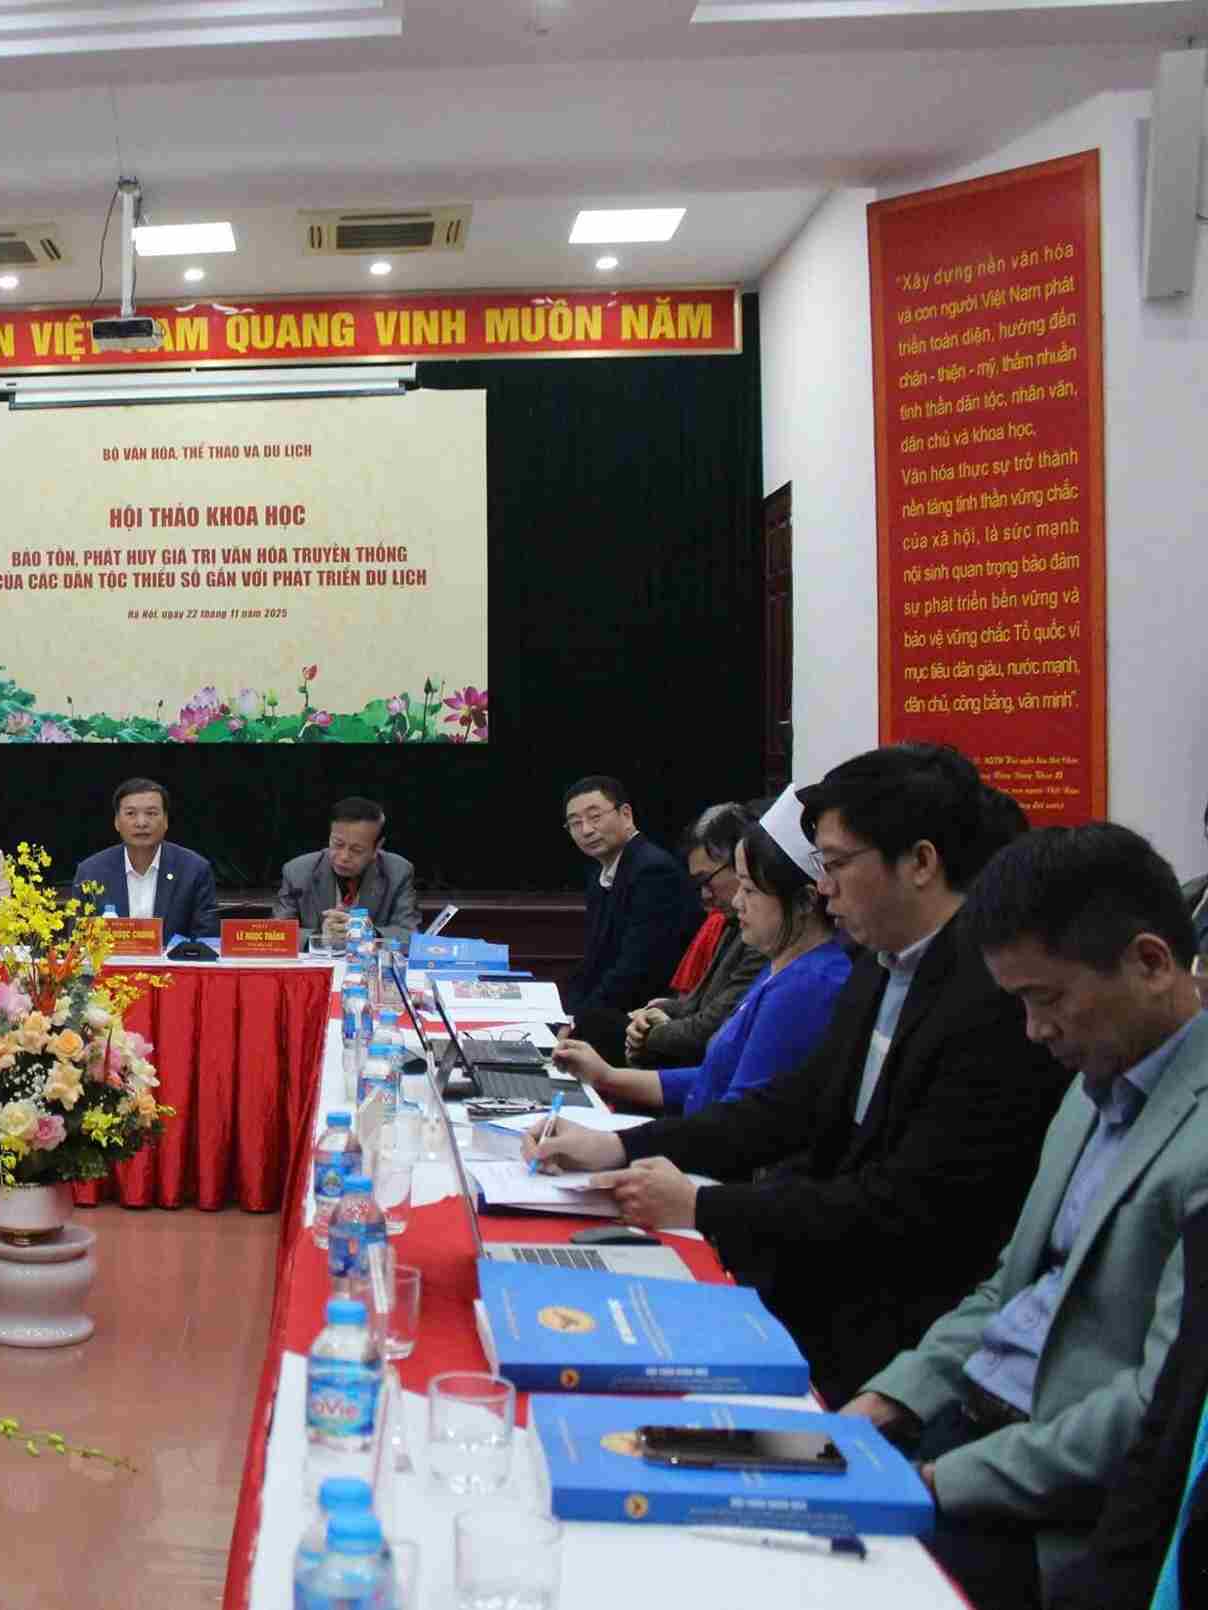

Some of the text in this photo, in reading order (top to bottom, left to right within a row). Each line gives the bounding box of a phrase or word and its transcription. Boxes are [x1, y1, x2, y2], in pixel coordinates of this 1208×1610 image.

[30, 313, 100, 362] VIỆ
[225, 311, 355, 354] QUANG
[375, 309, 466, 345] VINH
[485, 298, 602, 342] MUÔN
[620, 297, 712, 339] NĂM
[109, 501, 306, 531] HỘI THẢO KHOA HỌC
[186, 608, 198, 619] 22
[230, 608, 239, 619] 11
[264, 608, 288, 618] 2025
